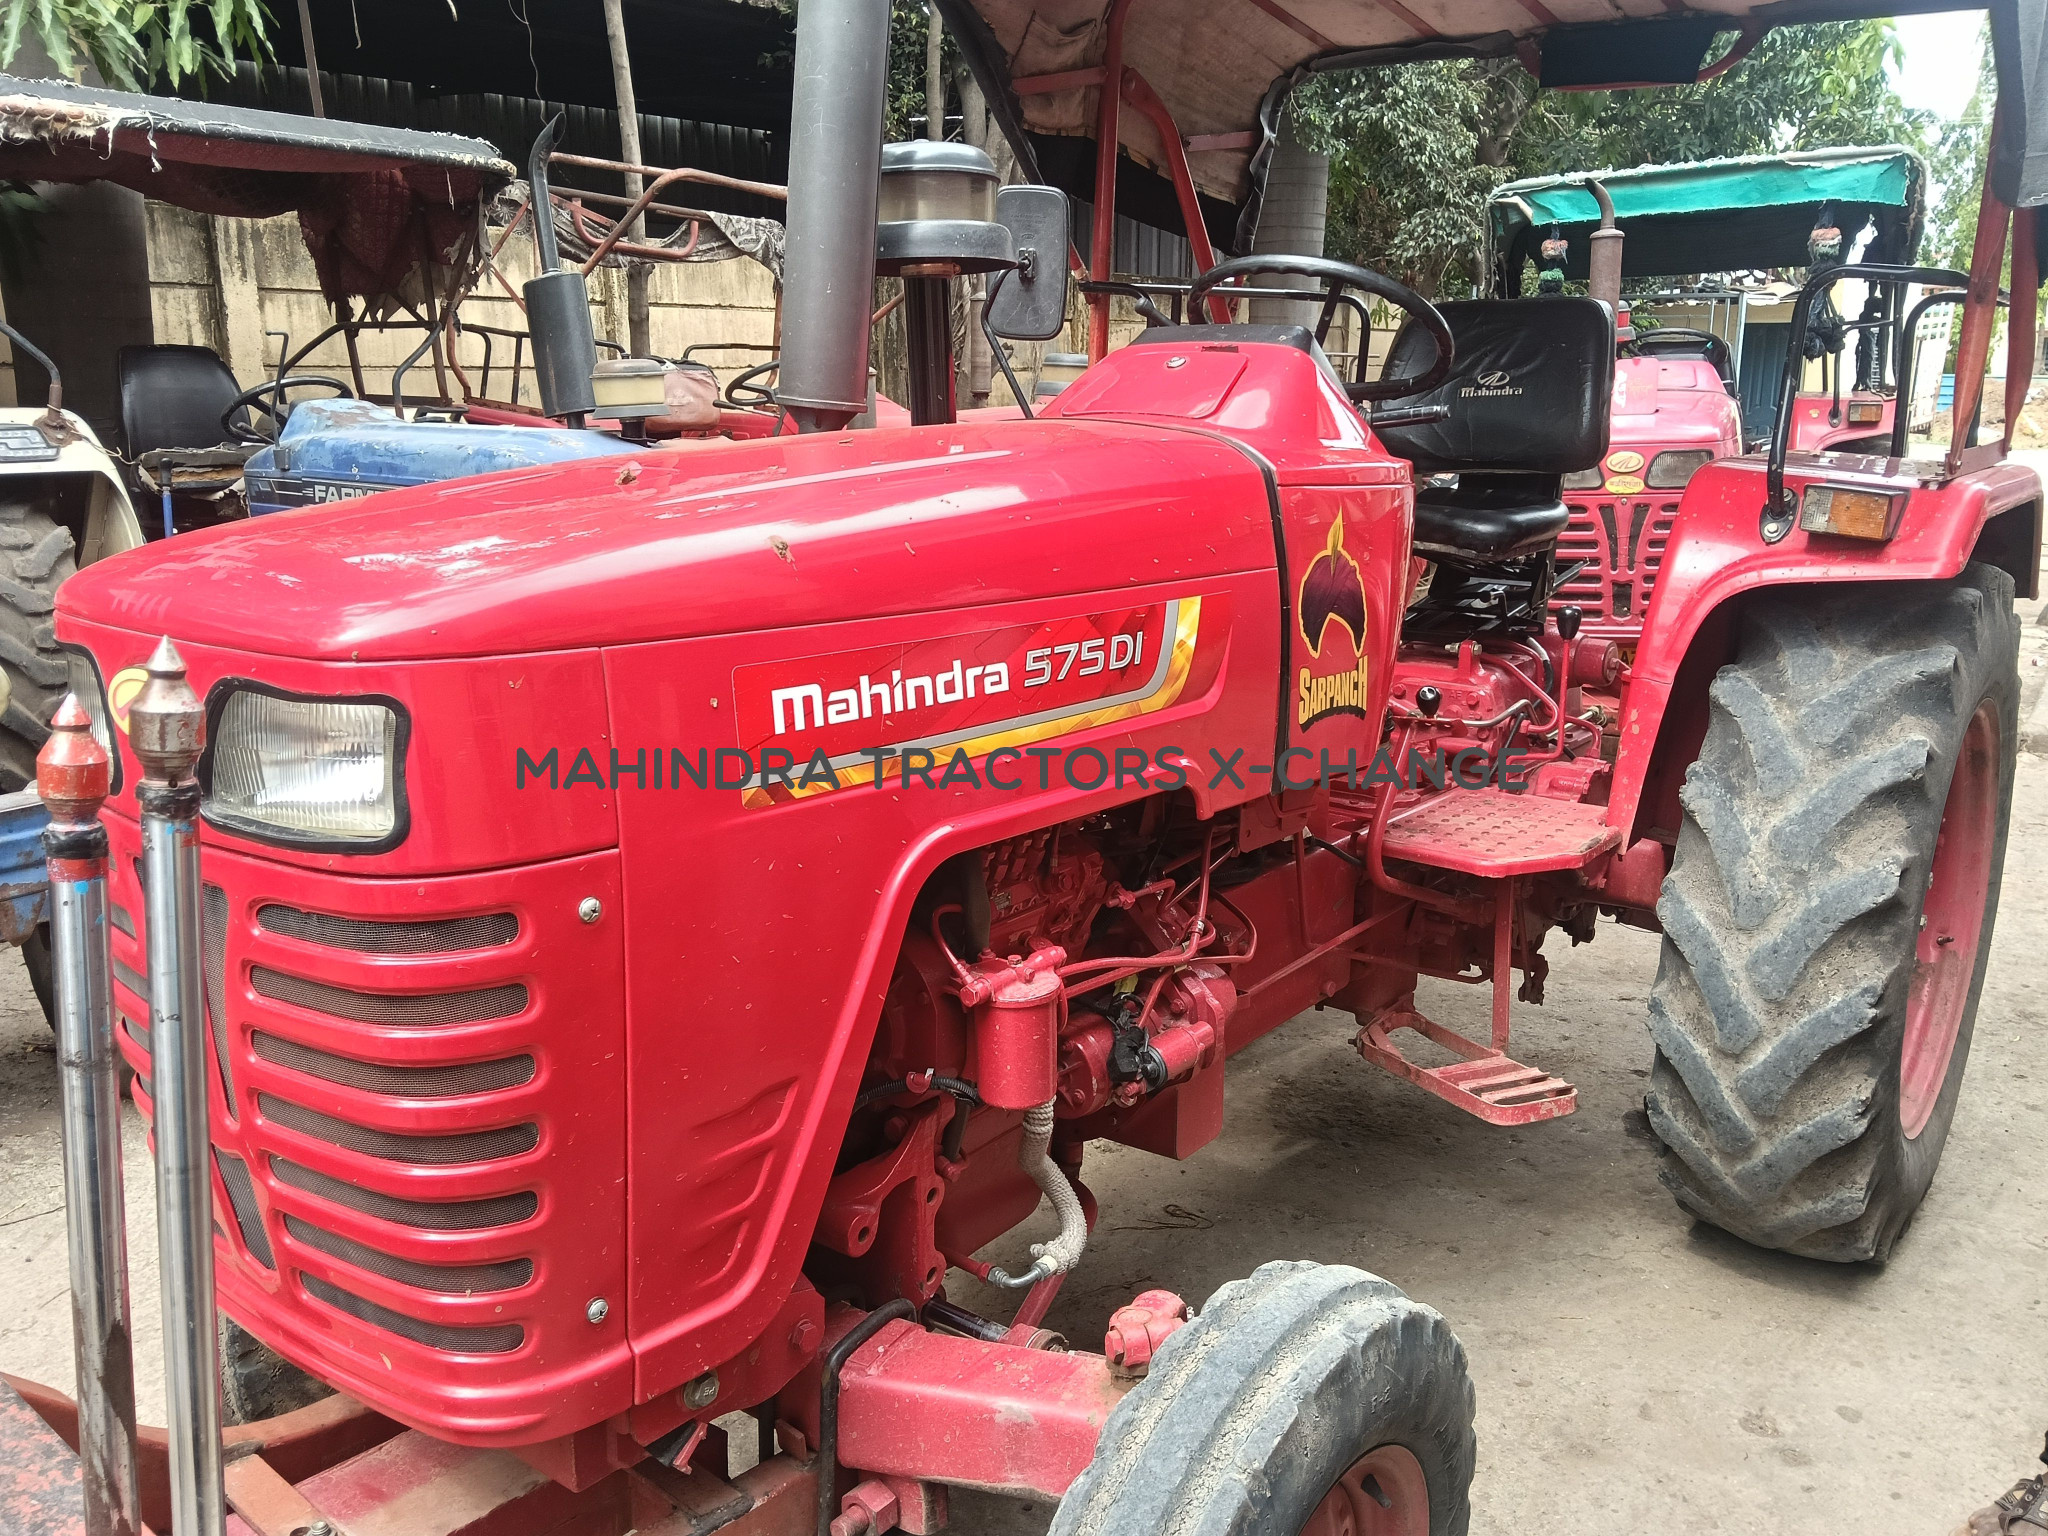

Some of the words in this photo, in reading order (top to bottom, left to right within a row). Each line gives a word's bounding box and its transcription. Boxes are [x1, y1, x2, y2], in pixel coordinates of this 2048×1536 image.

[1461, 386, 1523, 398] Mahindra
[771, 659, 1010, 735] Mahindra
[1299, 654, 1369, 725] SARPANCH
